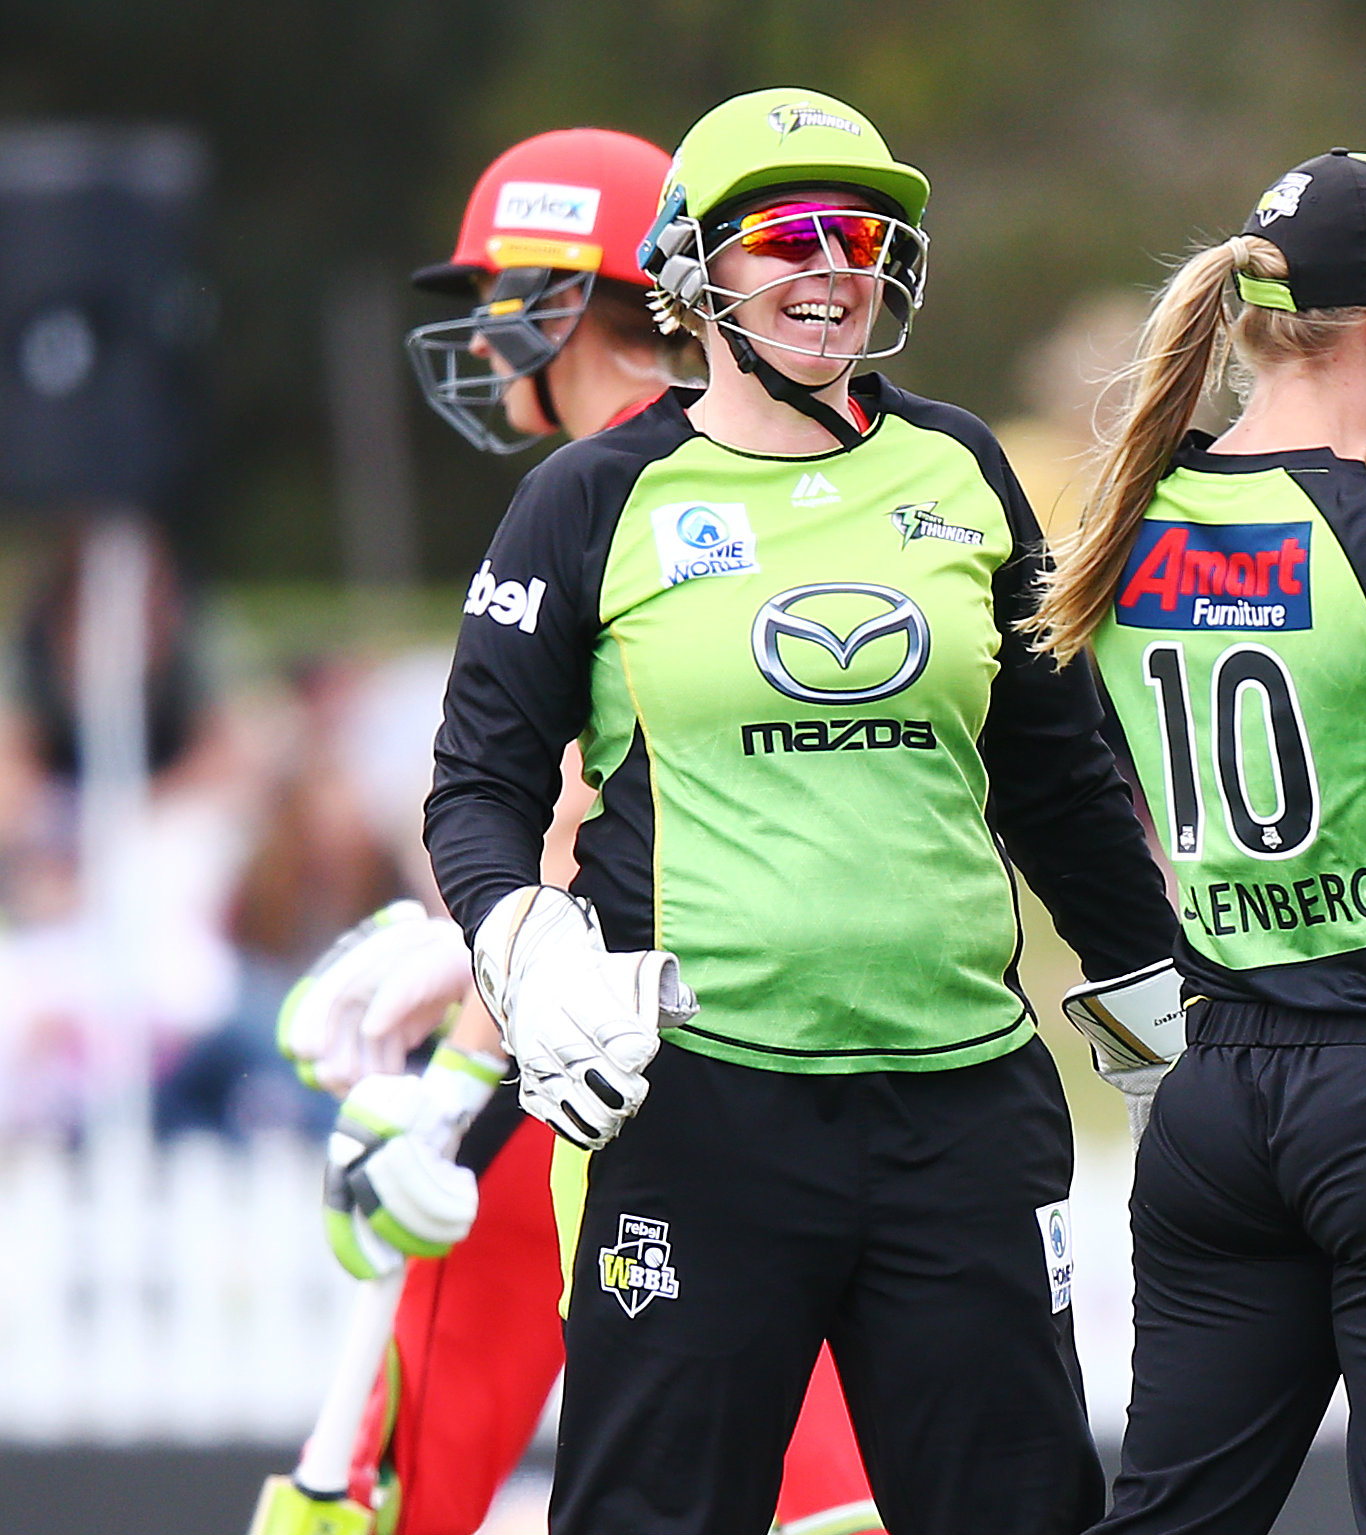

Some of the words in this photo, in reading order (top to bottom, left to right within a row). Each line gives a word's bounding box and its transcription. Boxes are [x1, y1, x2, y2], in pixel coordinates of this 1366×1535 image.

[798, 112, 861, 137] THUNDER
[920, 520, 983, 545] THUNDER
[1118, 527, 1307, 612] Amart
[462, 559, 548, 634] bel
[1192, 597, 1287, 627] Furniture
[1142, 640, 1321, 862] 10
[624, 1221, 661, 1240] rebel
[603, 1253, 675, 1296] WBBL
